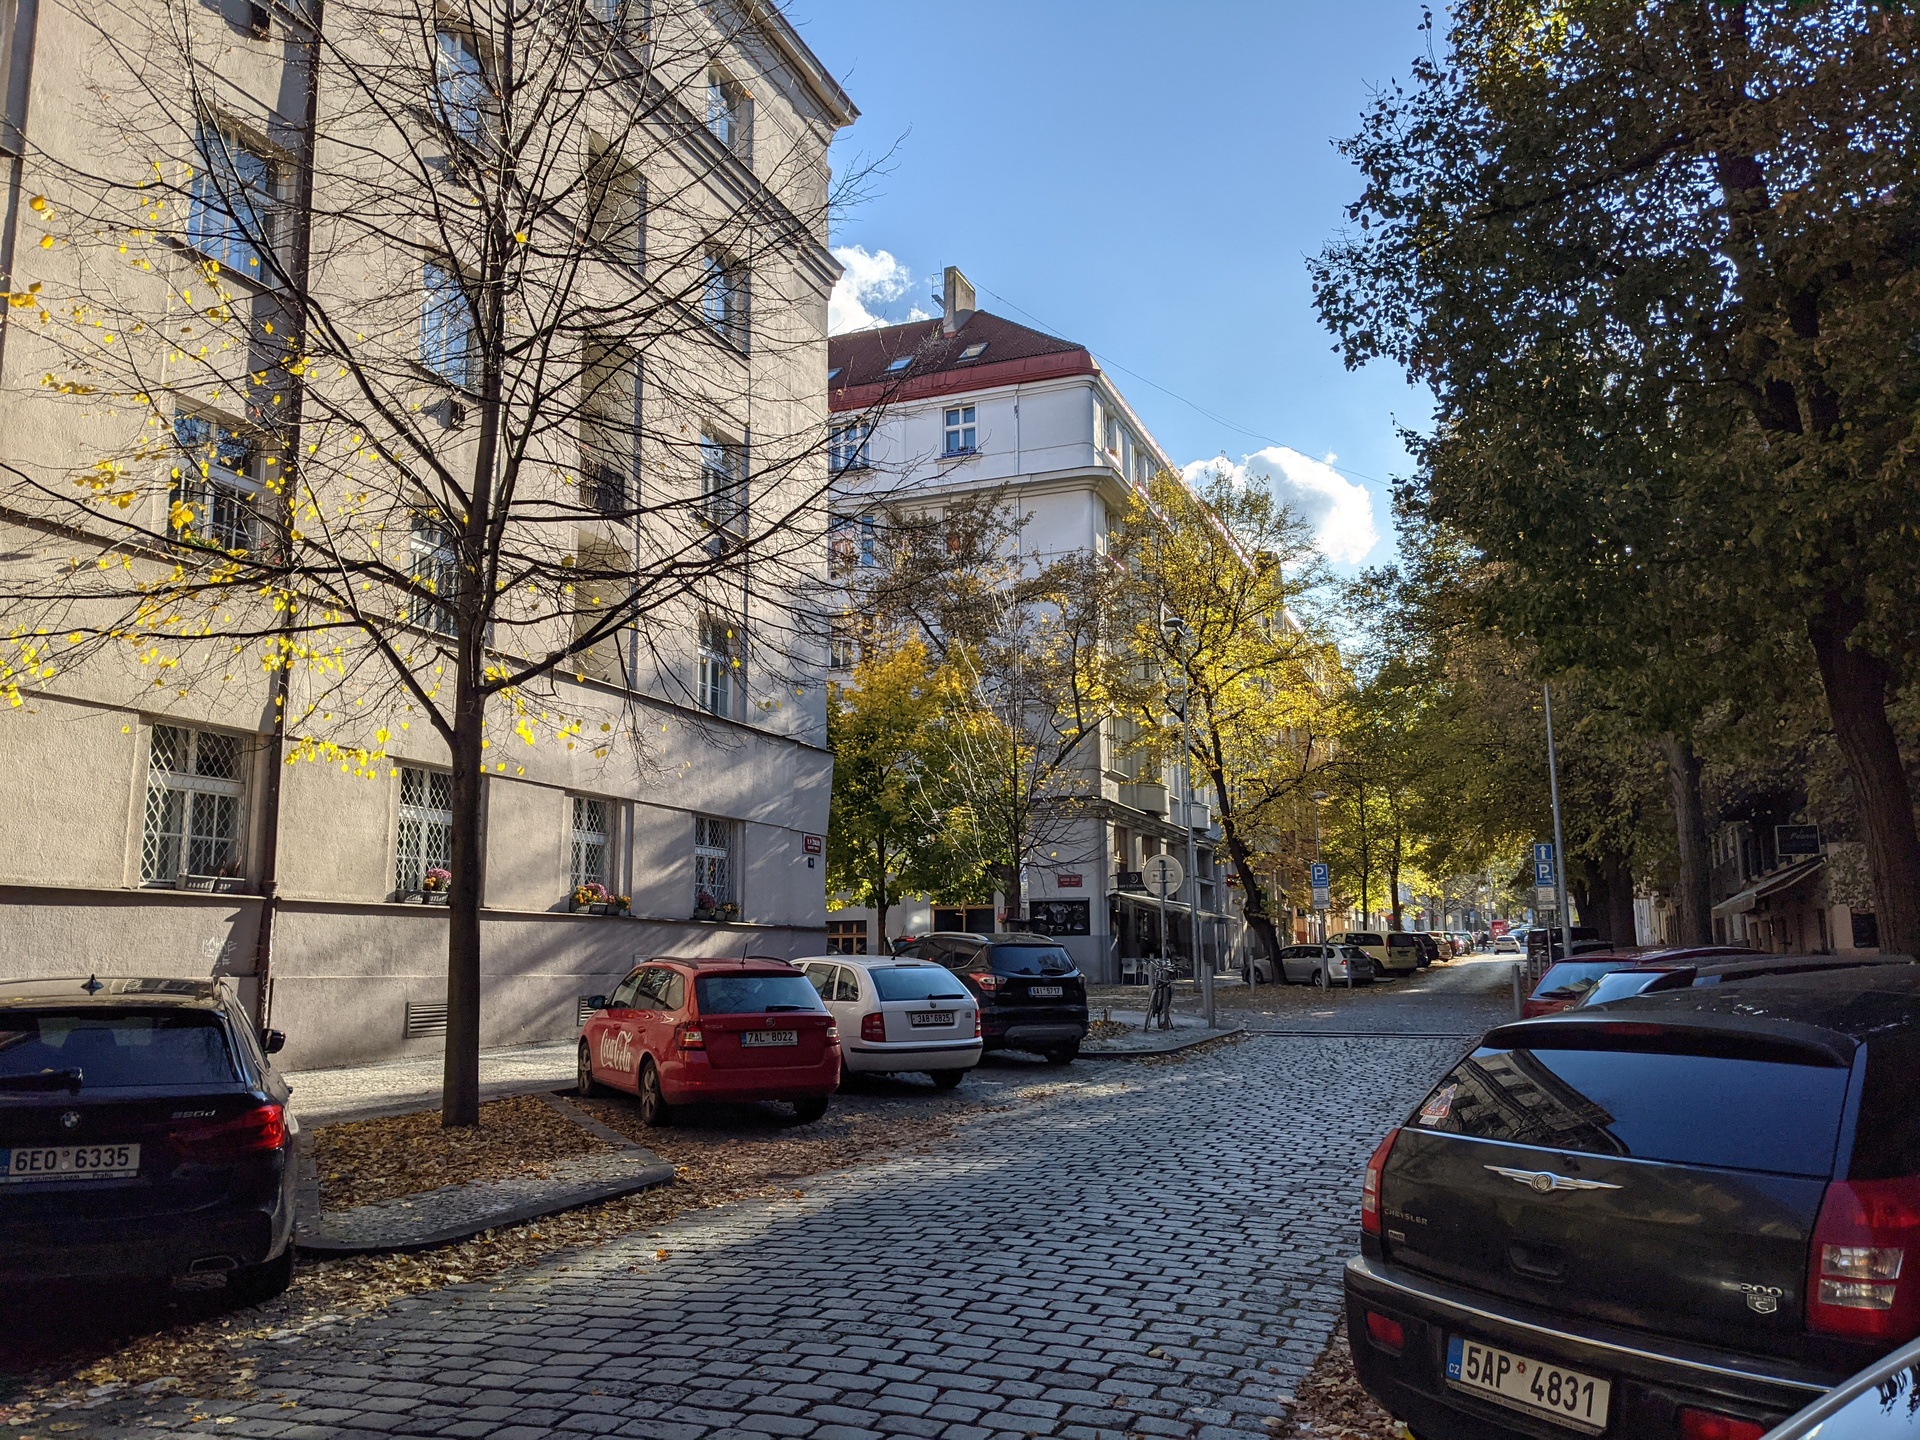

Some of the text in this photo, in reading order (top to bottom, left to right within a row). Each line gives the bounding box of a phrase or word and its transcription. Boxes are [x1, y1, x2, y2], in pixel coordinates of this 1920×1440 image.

[1313, 866, 1324, 880] P
[1538, 864, 1550, 879] P
[1046, 987, 1060, 995] 5717
[748, 1033, 766, 1043] 7AL
[771, 1031, 794, 1042] 8022
[74, 1147, 130, 1169] 6335
[1384, 1208, 1428, 1226] CHRYSLER
[1740, 1282, 1783, 1298] 300
[1448, 1362, 1461, 1376] CZ
[1466, 1345, 1596, 1418] 5AP 4831
